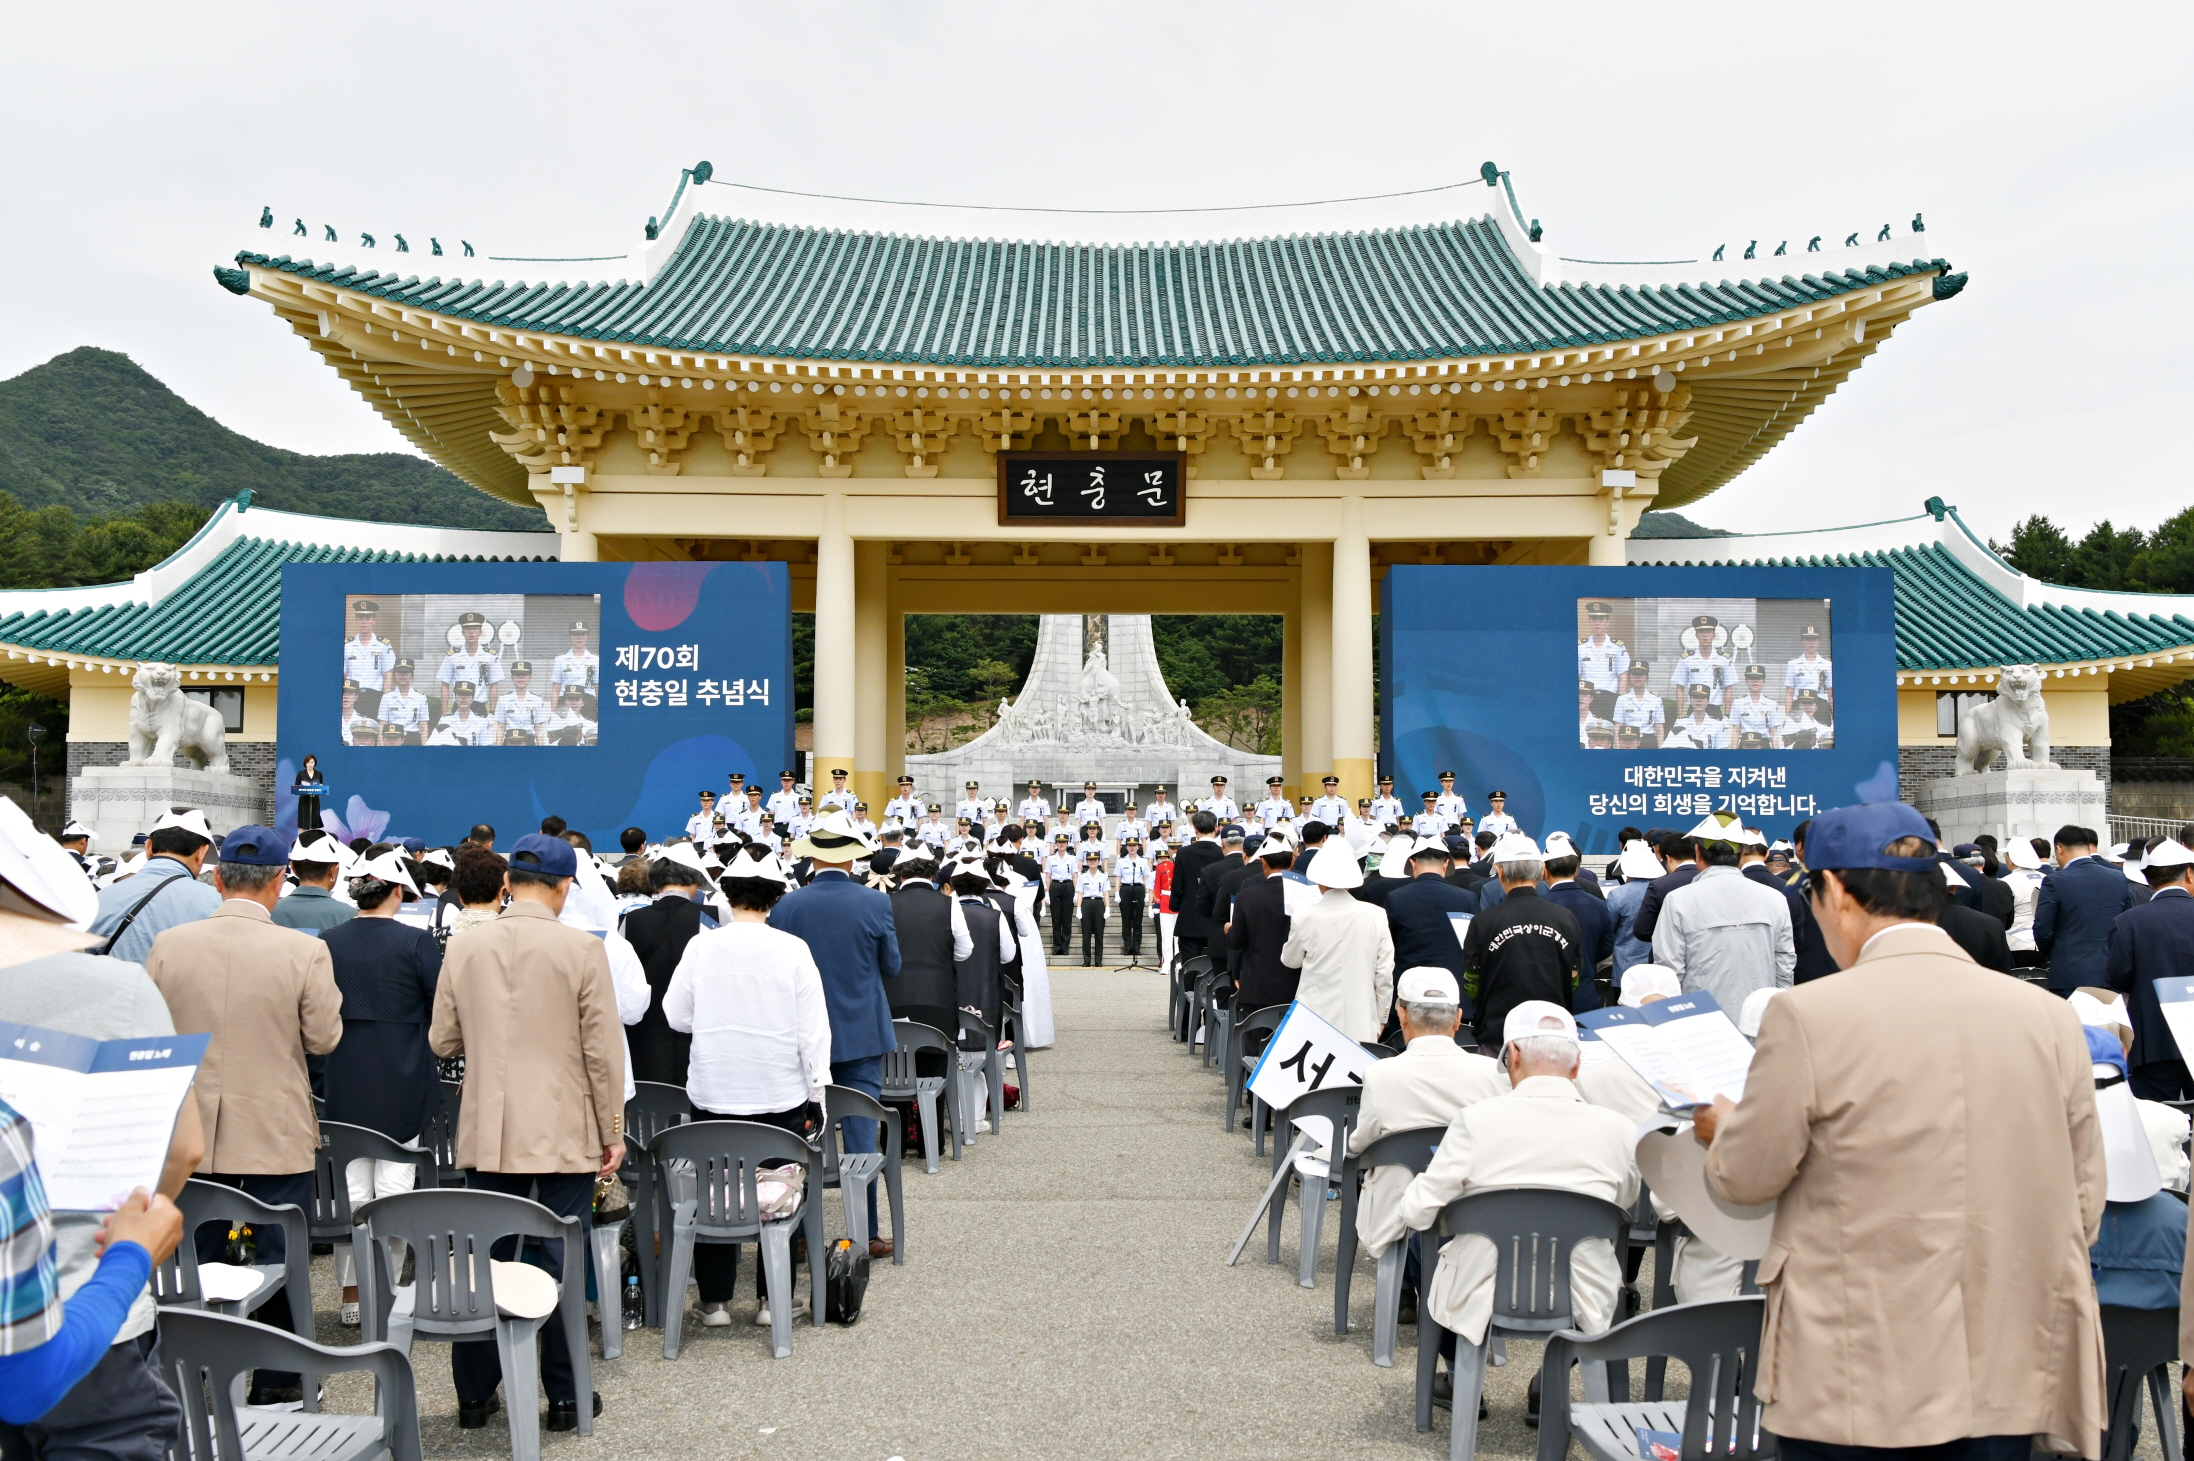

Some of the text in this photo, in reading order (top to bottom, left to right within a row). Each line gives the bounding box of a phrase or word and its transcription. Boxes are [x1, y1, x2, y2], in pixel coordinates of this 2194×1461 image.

[1020, 466, 1167, 509] 현충문
[615, 644, 699, 672] 제70회
[614, 678, 769, 706] 현충일 추념식
[1624, 766, 1787, 788] 대한민국을 지켜낸
[1589, 793, 1822, 816] 당신의 희생을 기억합니다.
[1488, 923, 1569, 952] 대한민국상이군경회
[1279, 1039, 1363, 1092] 서
